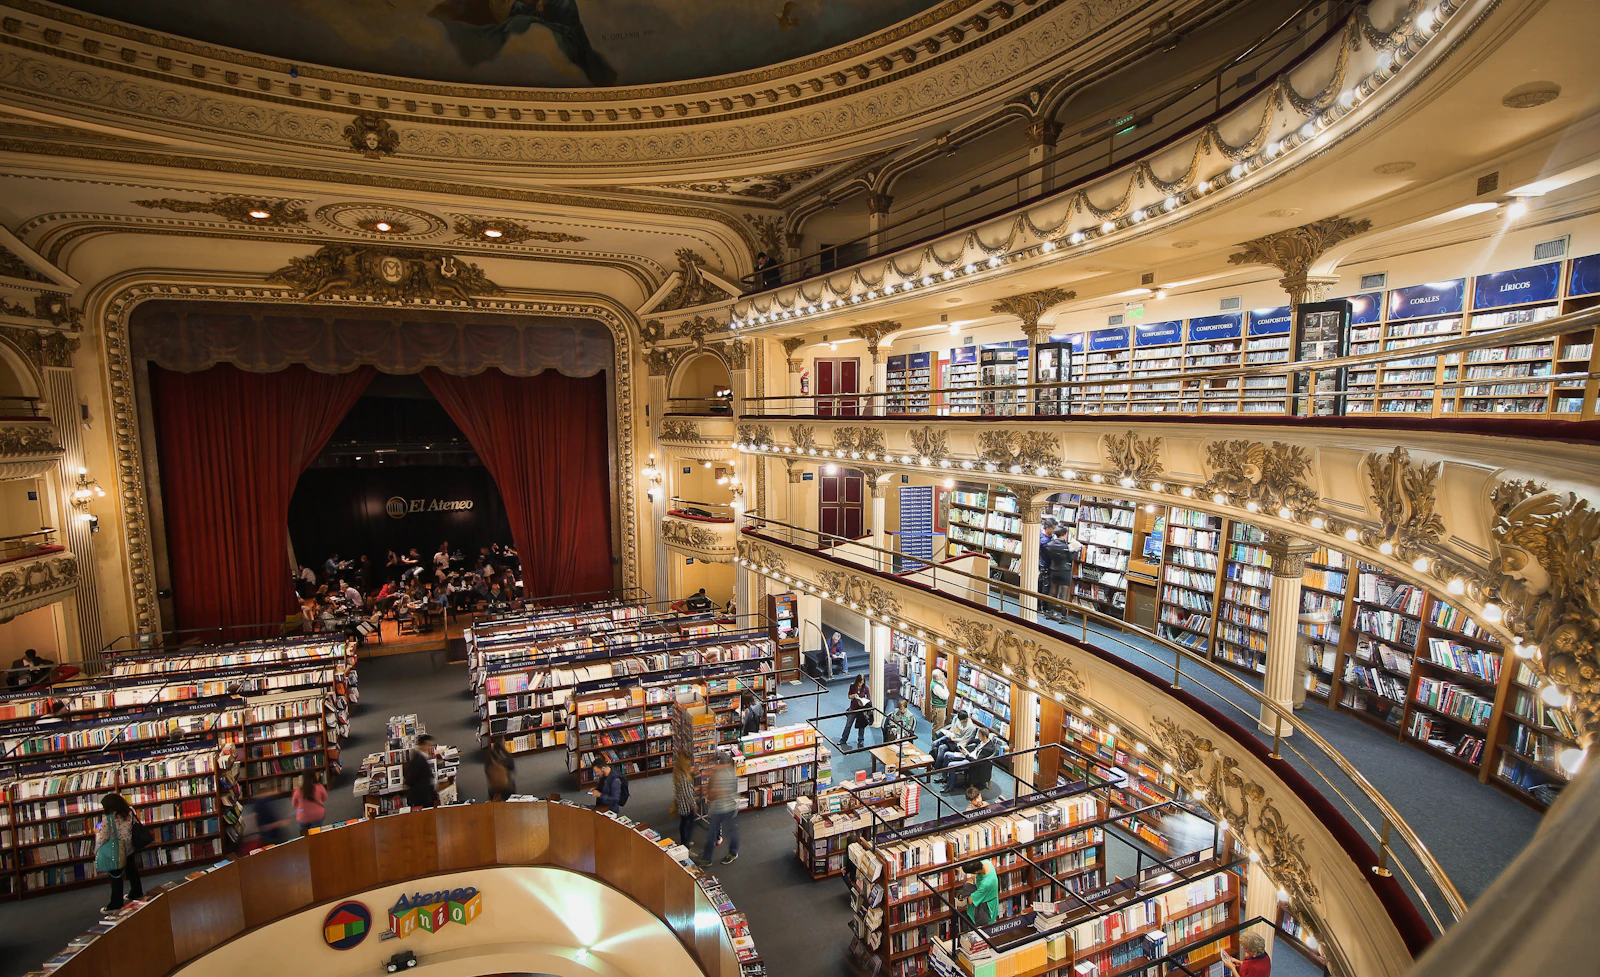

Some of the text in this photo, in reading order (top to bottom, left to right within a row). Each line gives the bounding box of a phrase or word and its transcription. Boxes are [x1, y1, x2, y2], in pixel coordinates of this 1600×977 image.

[1500, 280, 1531, 293] LÍRICOS
[1409, 294, 1440, 305] CORALES
[1257, 316, 1292, 325] COMPOSITOR
[1142, 329, 1175, 337] COMPOSITORES
[1196, 323, 1233, 332] COMPOSITORES
[1094, 335, 1123, 343] COMPOSITORES
[408, 498, 474, 513] El Ateneo
[392, 886, 477, 912] Ateneo
[1084, 888, 1111, 901] DERECHO
[390, 899, 480, 934] Junior
[991, 919, 1022, 934] DERECHO
